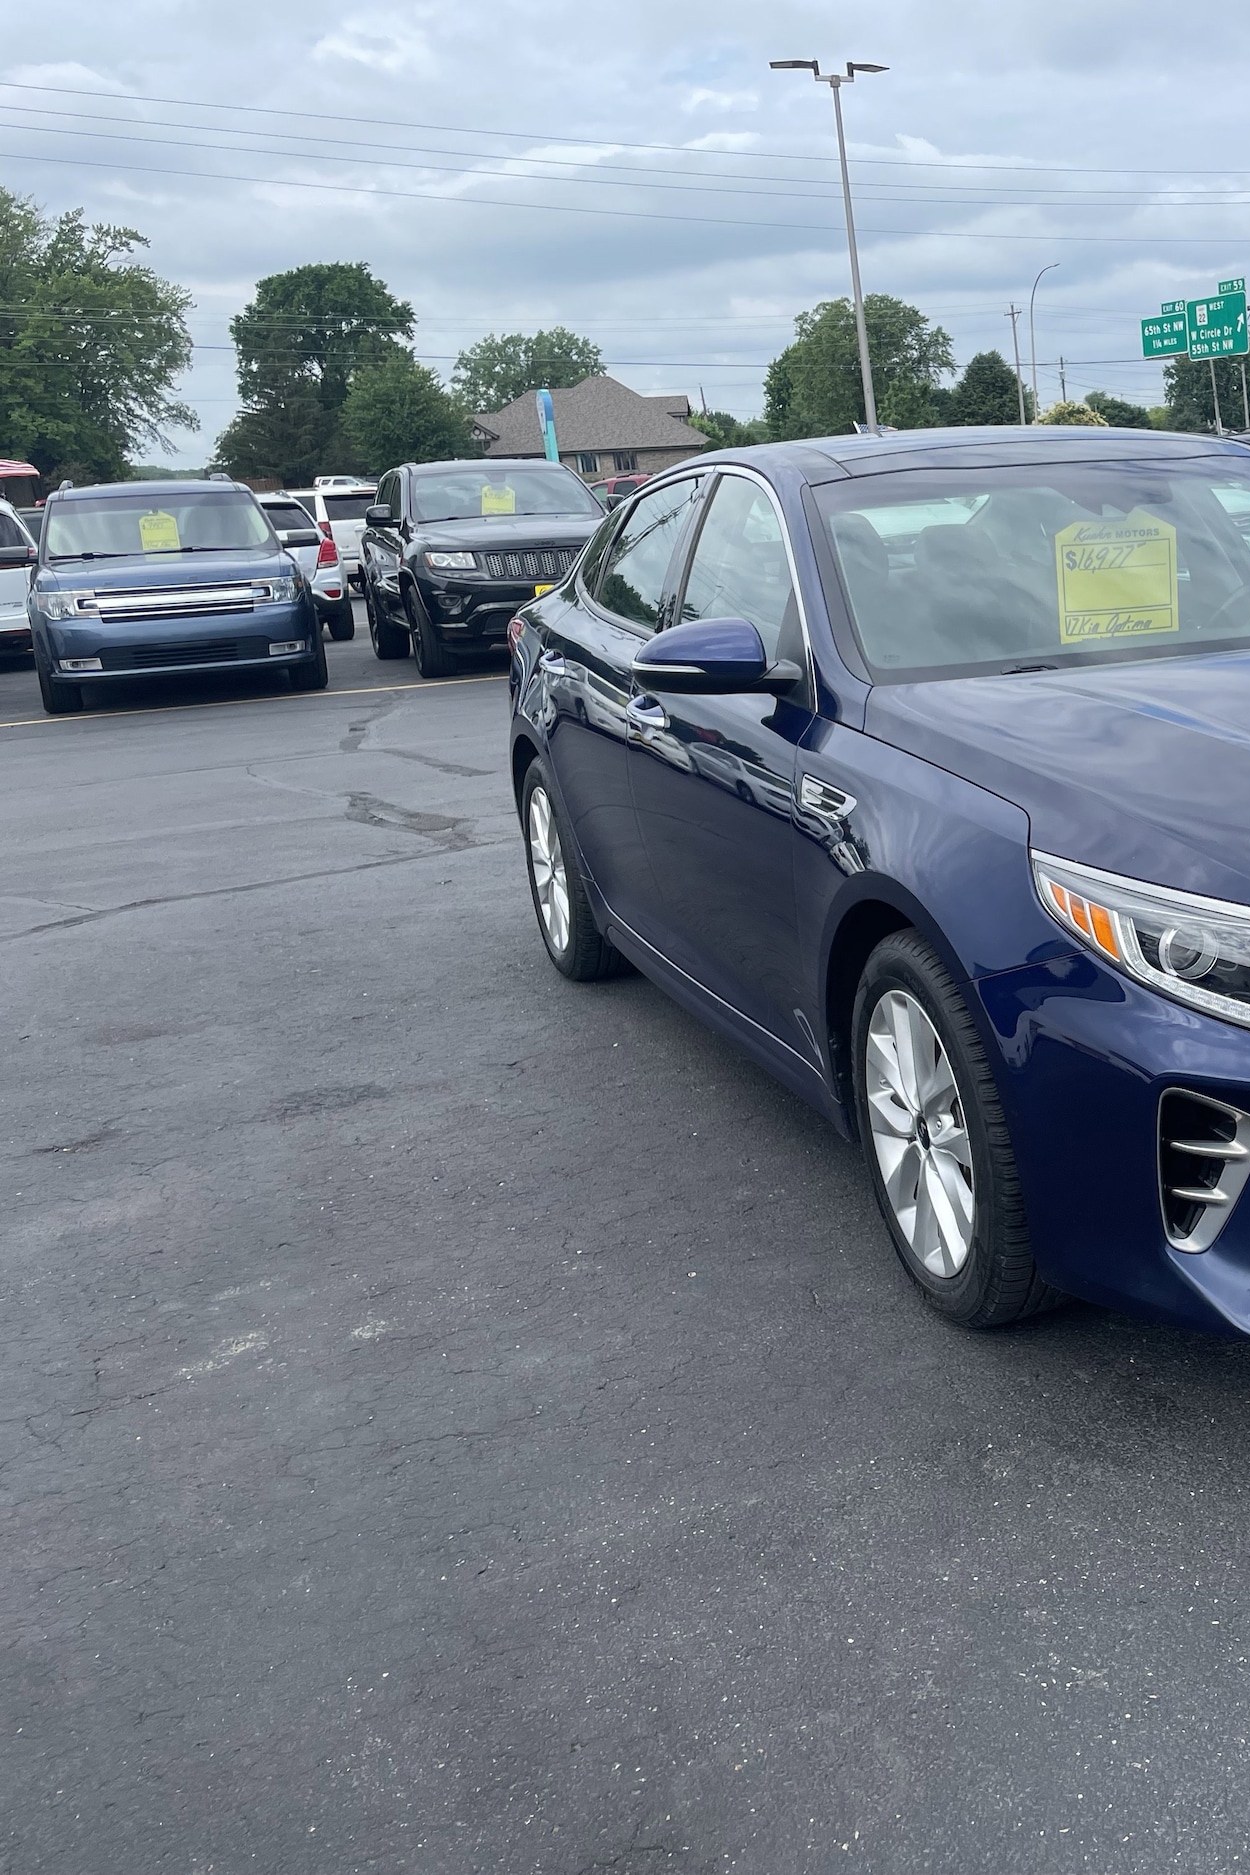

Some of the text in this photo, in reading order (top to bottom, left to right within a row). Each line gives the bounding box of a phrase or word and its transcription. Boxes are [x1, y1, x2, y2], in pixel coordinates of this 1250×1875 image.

[1220, 280, 1243, 292] EXIT 59
[1162, 301, 1184, 313] EXIT 60
[1209, 301, 1225, 311] WEST
[1198, 313, 1206, 323] 22
[1144, 320, 1184, 336] 65th St NW
[1191, 325, 1233, 341] W Circle Dr
[1163, 337, 1178, 346] MILES
[1191, 339, 1234, 355] 55th St NW
[1115, 528, 1160, 539] MOTORS
[1080, 616, 1099, 634] Kia
